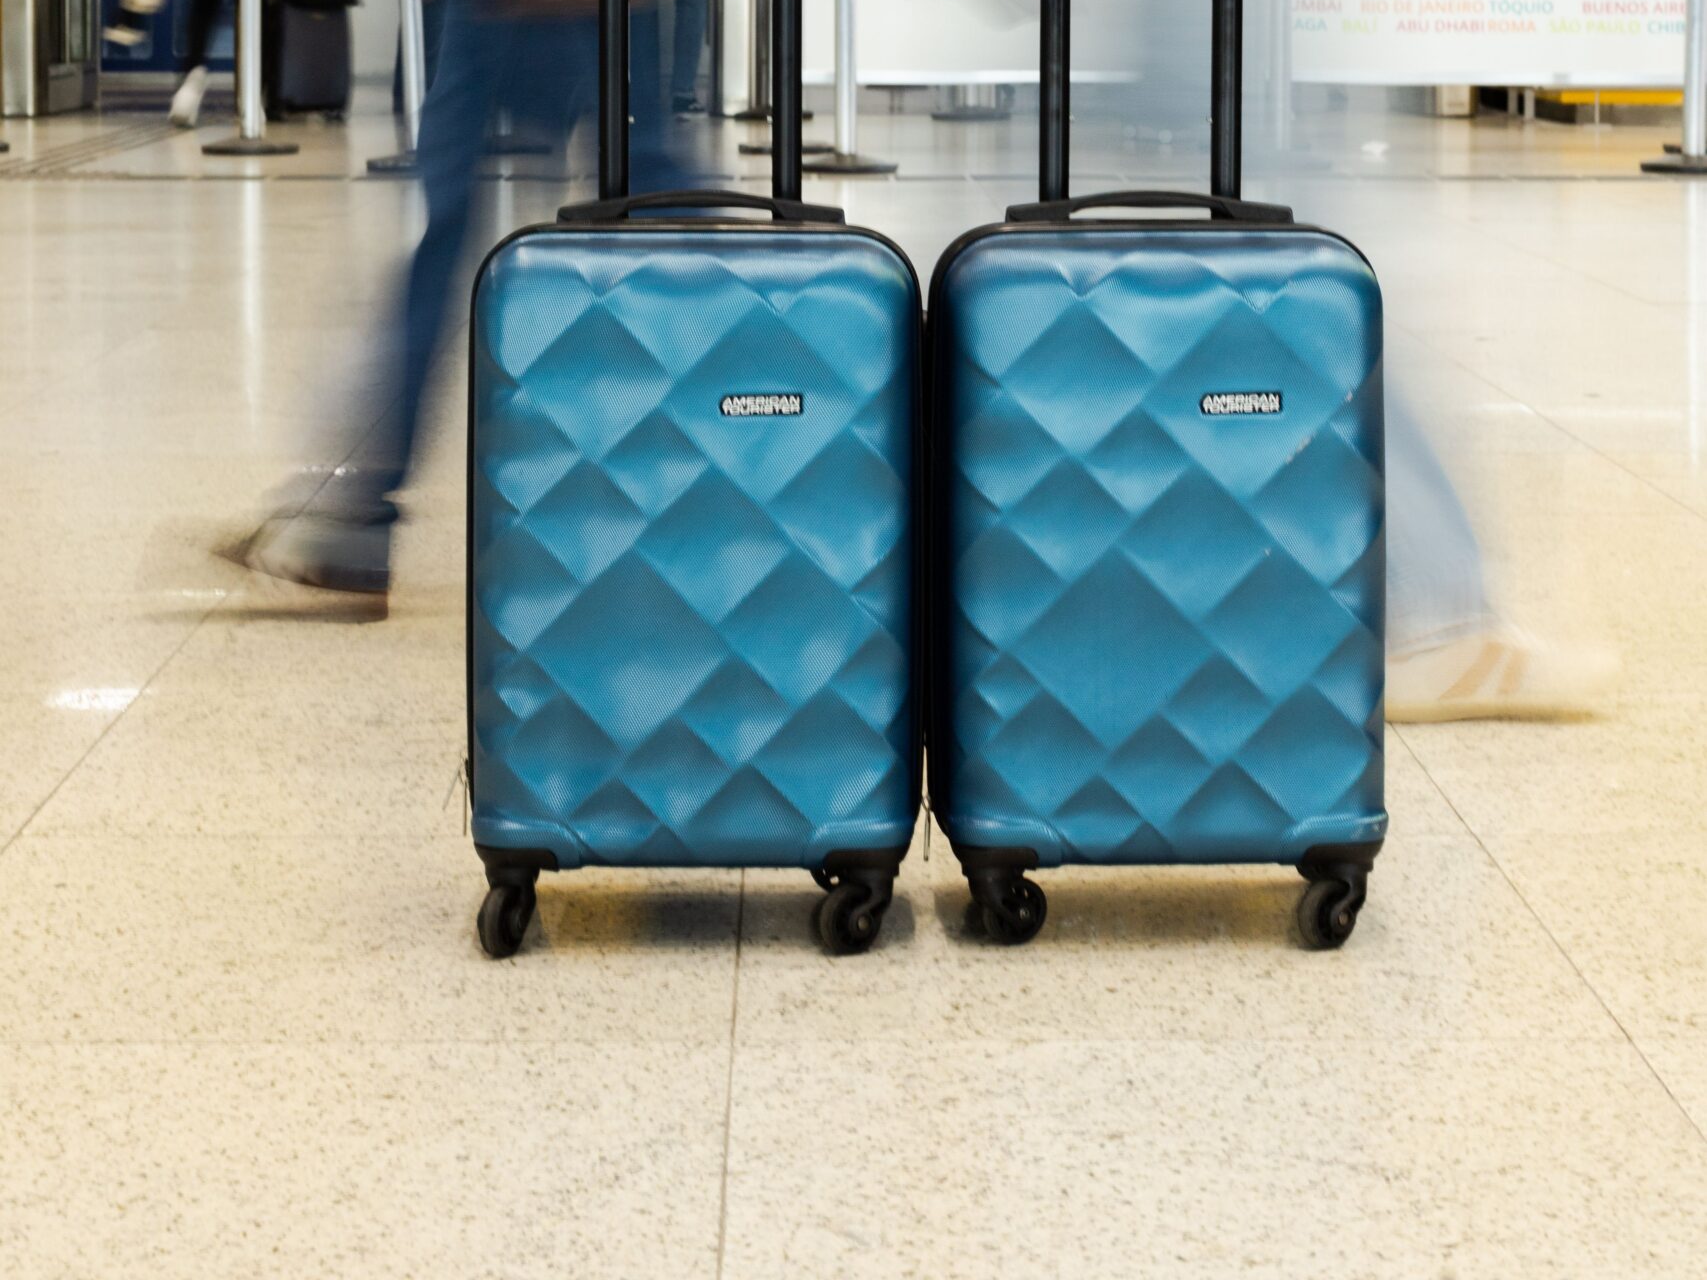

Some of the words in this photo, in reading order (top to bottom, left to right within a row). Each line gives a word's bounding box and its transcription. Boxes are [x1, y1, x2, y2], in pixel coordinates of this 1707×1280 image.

[1360, 1, 1390, 15] RIO
[1393, 1, 1414, 15] DE
[1418, 1, 1485, 17] JANEIRO
[1581, 1, 1649, 15] BUENOS
[1396, 19, 1430, 34] ABU
[1434, 19, 1485, 34] DHABI
[1487, 20, 1537, 34] ROMA
[1585, 20, 1641, 34] PAULO
[722, 396, 801, 406] AMERICAN
[1202, 394, 1280, 404] AMERICAN
